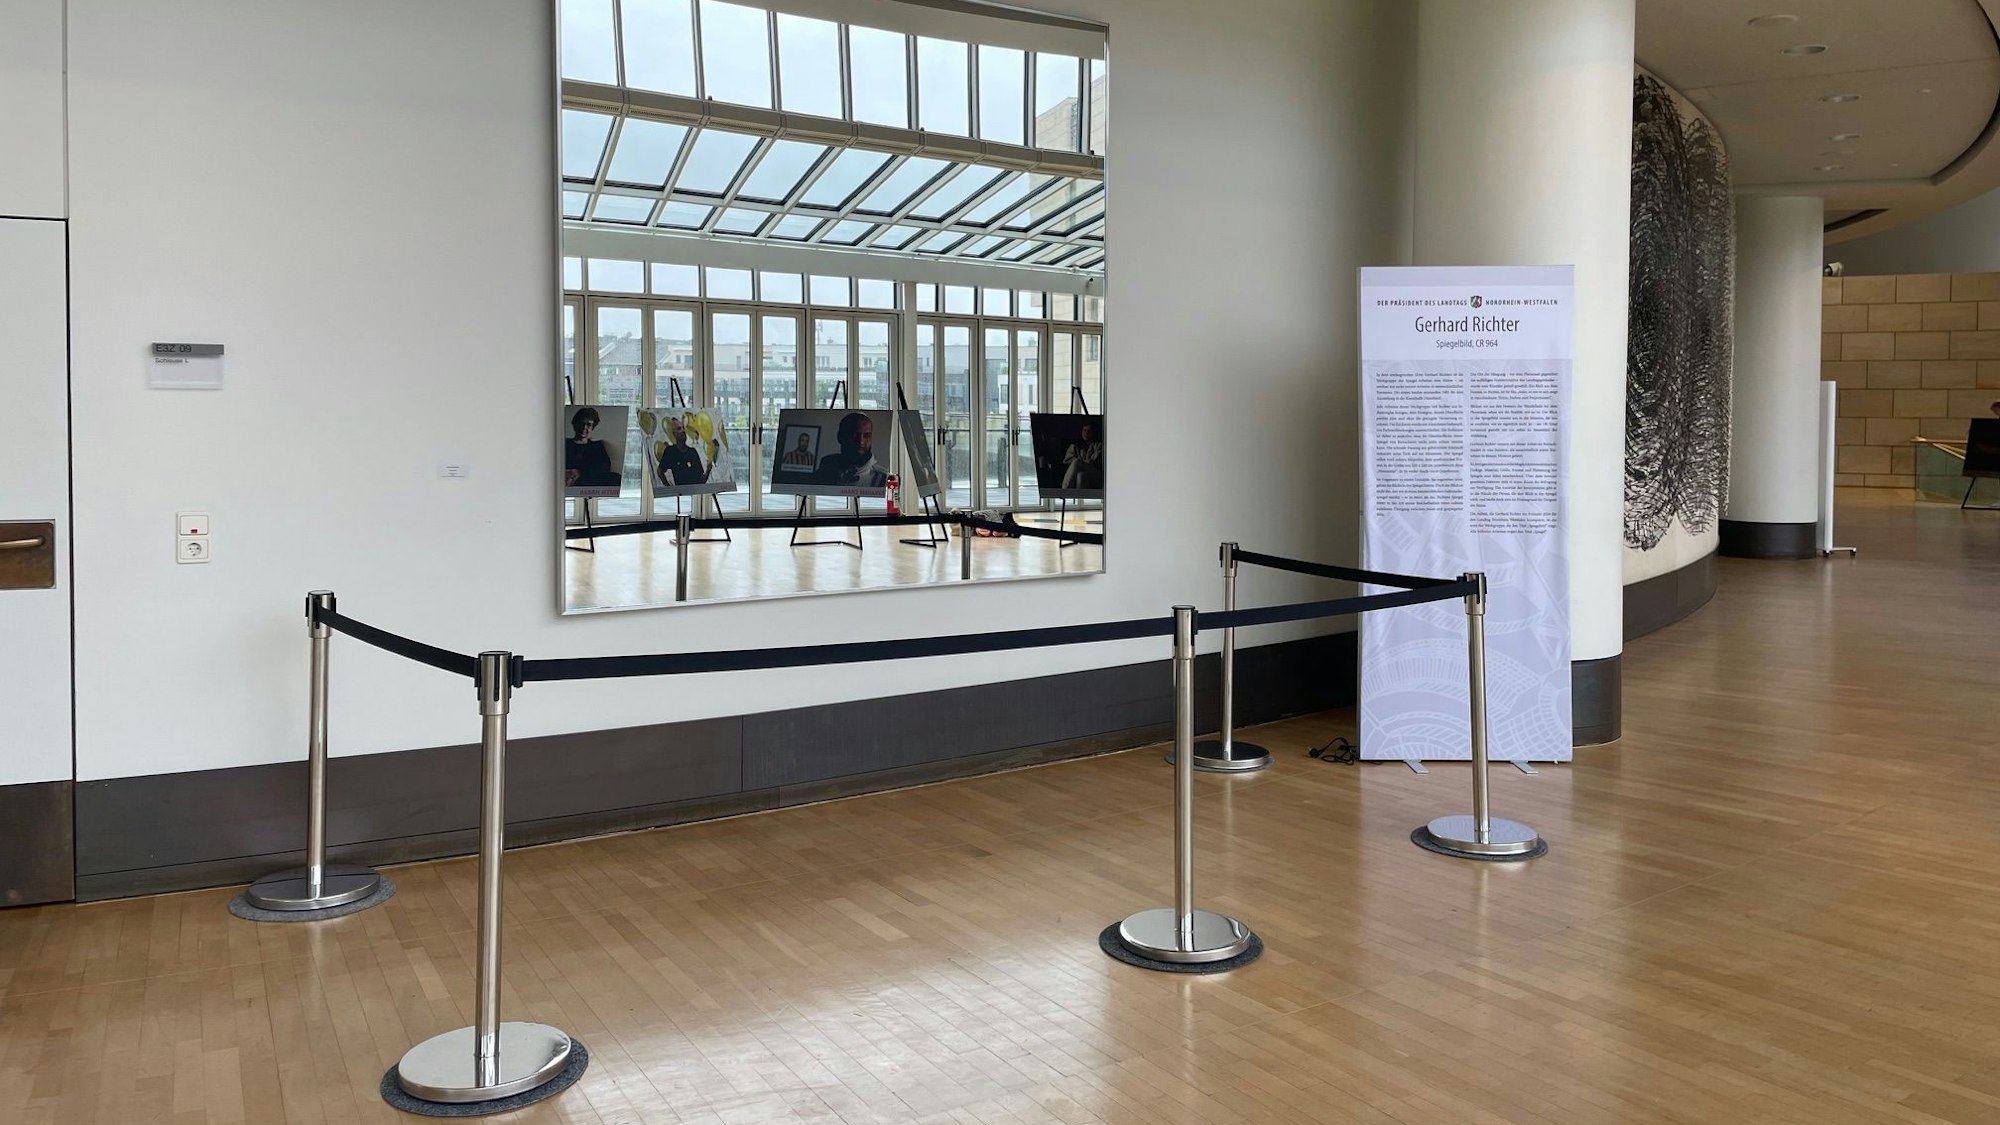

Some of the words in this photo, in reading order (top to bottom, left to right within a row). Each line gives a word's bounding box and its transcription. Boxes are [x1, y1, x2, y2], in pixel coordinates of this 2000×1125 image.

[1376, 299, 1388, 307] DER
[1390, 298, 1423, 307] PRÄSIDENT
[1425, 299, 1436, 307] DES
[1437, 299, 1468, 307] LANDTAGS
[1415, 316, 1468, 333] Gerhard
[1472, 316, 1520, 333] Richter
[156, 343, 176, 353] E3Z
[179, 344, 192, 353] 09
[1436, 339, 1474, 350] Spiegelbild,
[1476, 339, 1485, 348] CR
[1485, 339, 1498, 348] 964
